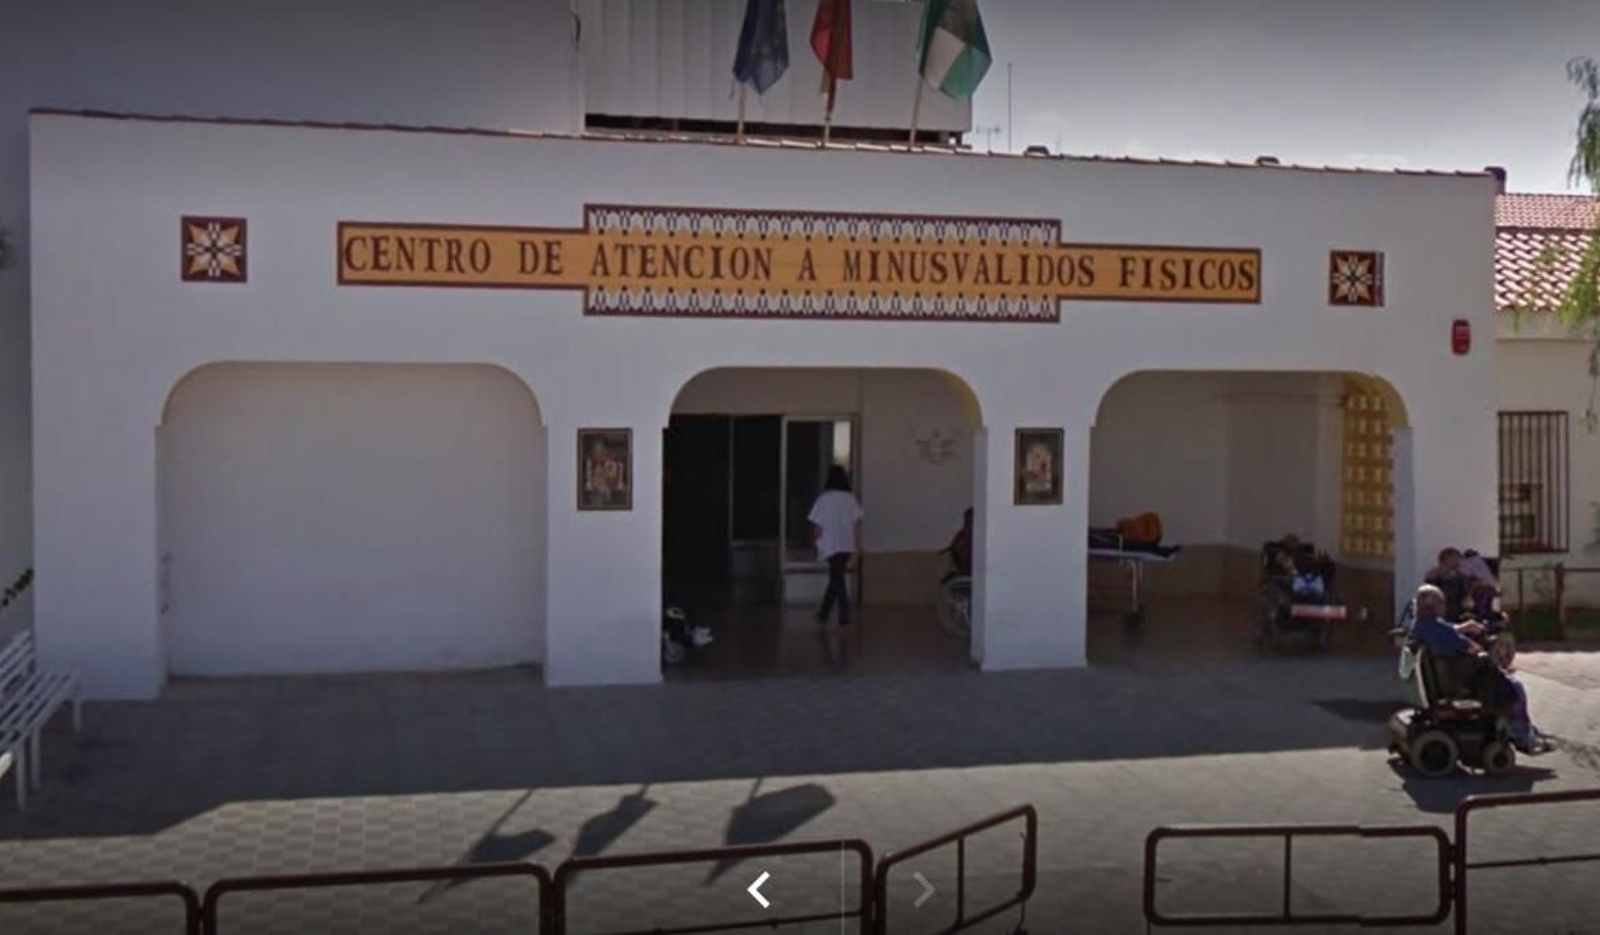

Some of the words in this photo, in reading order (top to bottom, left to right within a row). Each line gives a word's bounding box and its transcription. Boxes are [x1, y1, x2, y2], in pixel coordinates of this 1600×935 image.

[344, 235, 492, 274] CENTRO
[519, 240, 564, 275] DE
[591, 242, 773, 281] ATENCION
[797, 248, 817, 282] A
[843, 249, 1095, 287] MINUSVALIDOS
[1119, 256, 1255, 291] FISICOS
